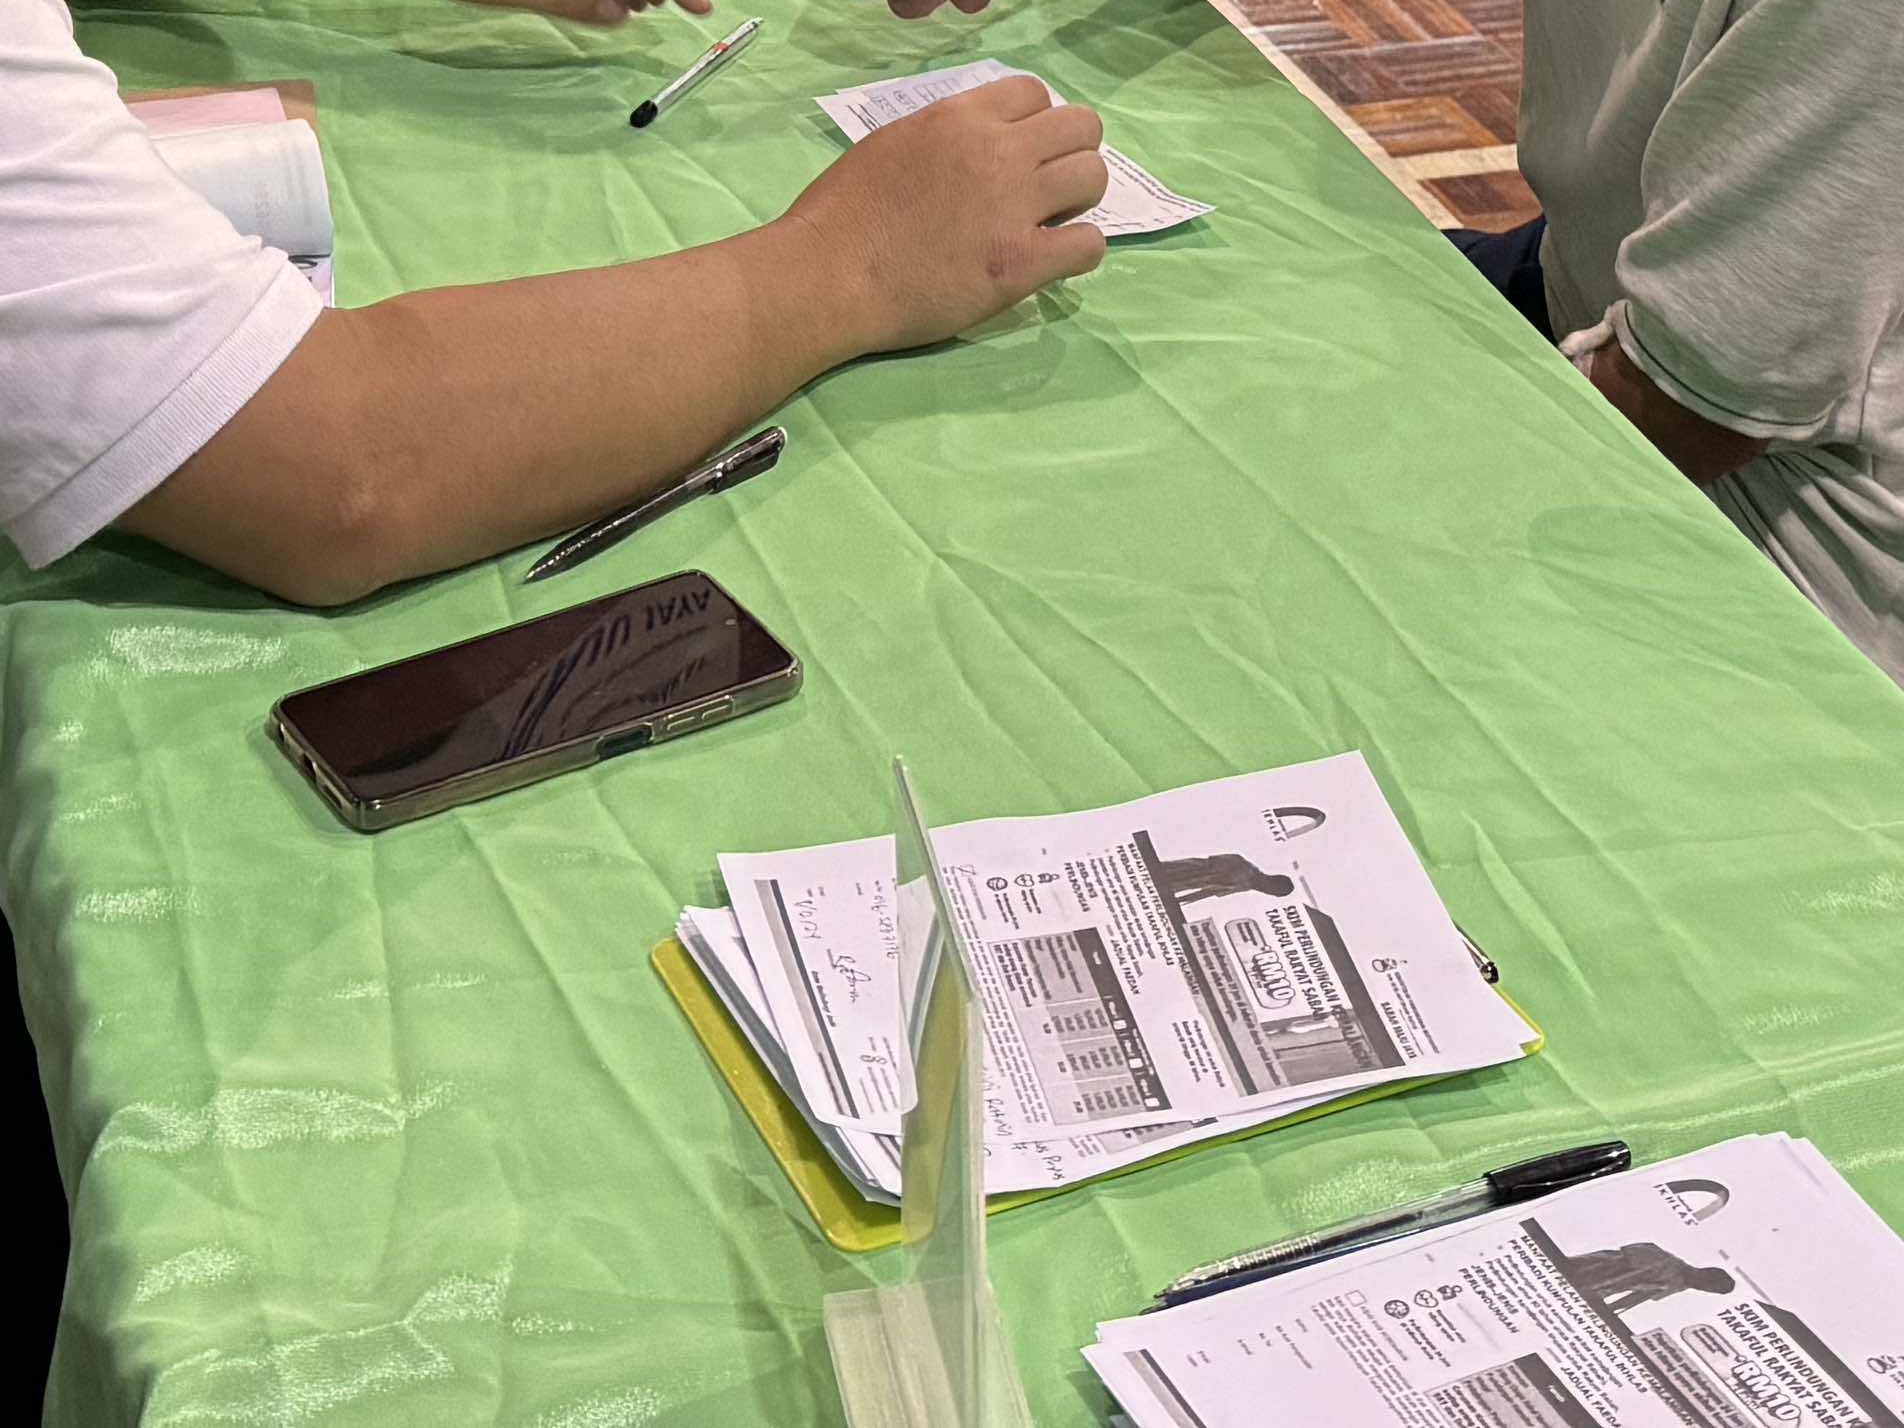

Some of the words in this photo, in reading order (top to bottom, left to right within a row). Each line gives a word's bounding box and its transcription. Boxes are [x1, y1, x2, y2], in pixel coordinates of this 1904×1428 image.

[1264, 909, 1292, 947] TAKAFUL
[1283, 948, 1311, 986] RAKYAT
[1281, 905, 1304, 928] SKIM
[1293, 929, 1340, 1002] PERLINDUNGAN
[1715, 1308, 1770, 1357] TAKAFUL
[1761, 1355, 1813, 1401] RAKYAT
[1729, 1358, 1803, 1424] RM10
[1733, 1300, 1773, 1331] SKIM
[1761, 1330, 1853, 1418] PERLINDUNGAN
